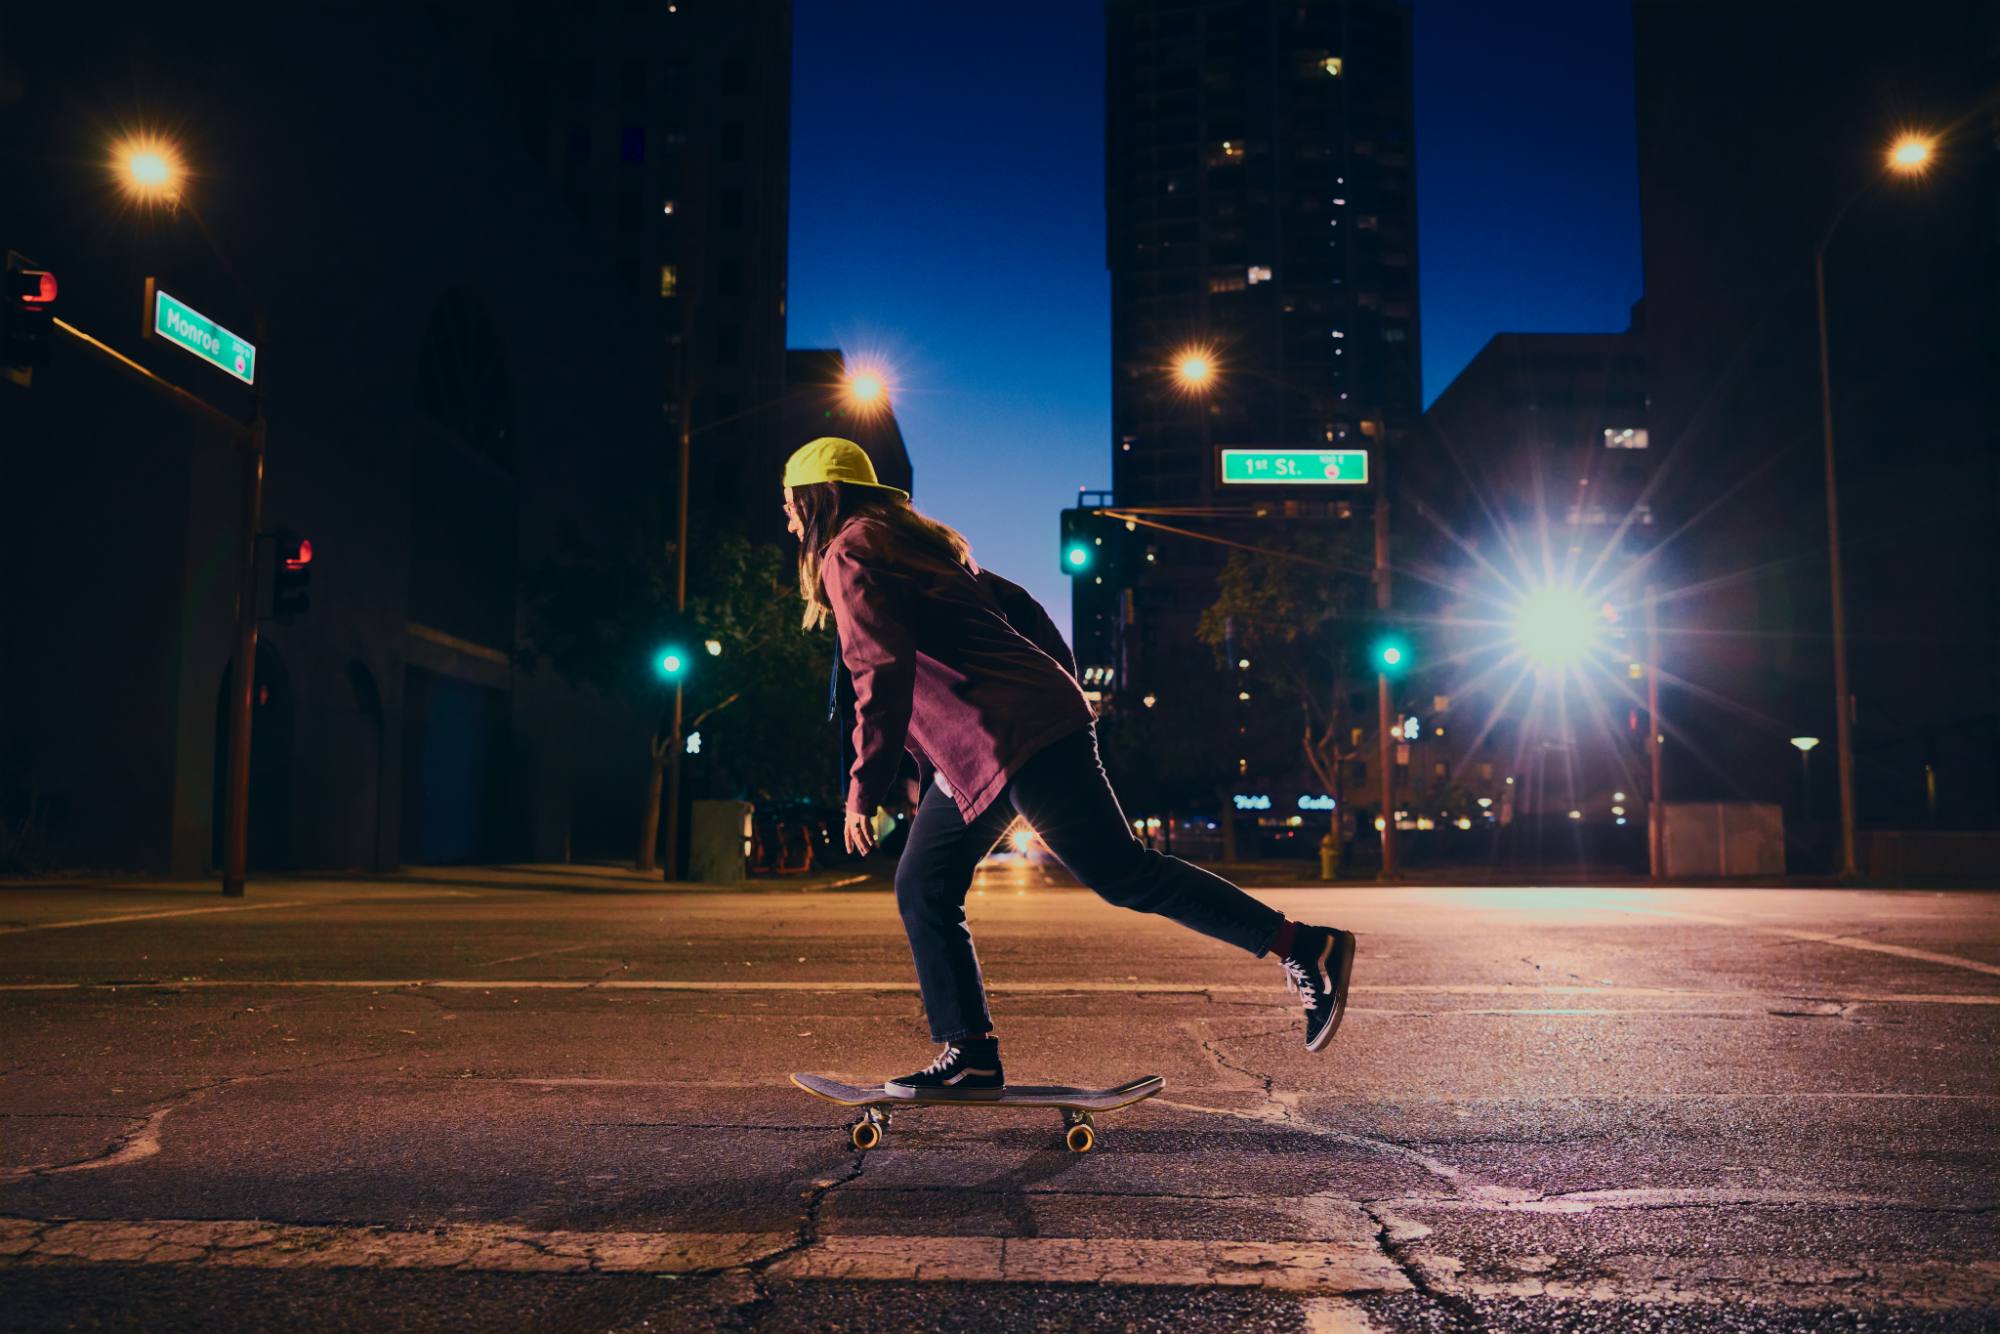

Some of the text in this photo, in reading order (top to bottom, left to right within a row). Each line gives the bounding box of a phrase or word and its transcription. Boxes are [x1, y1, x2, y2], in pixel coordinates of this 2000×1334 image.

[167, 308, 220, 355] Monroe
[1245, 458, 1268, 475] 1st
[1275, 458, 1302, 476] St.
